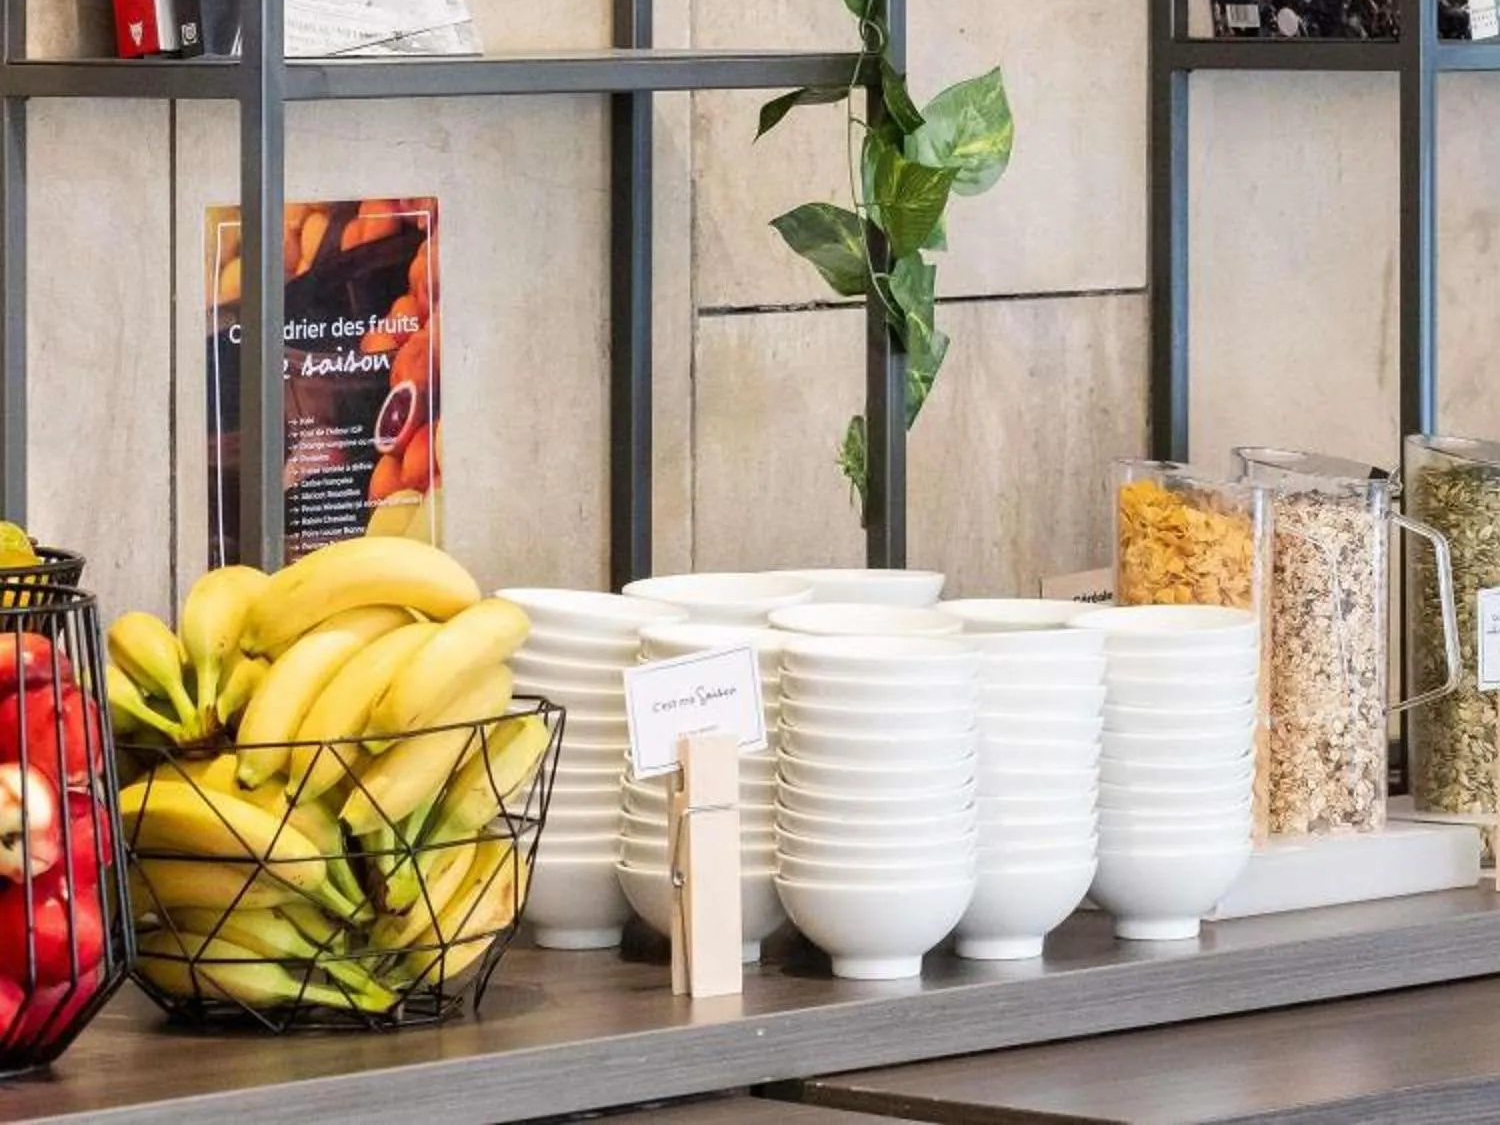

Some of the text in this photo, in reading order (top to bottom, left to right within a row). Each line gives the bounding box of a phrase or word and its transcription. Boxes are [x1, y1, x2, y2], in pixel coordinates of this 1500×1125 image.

[229, 313, 420, 345] Cdrier des fruits
[300, 346, 390, 376] saison
